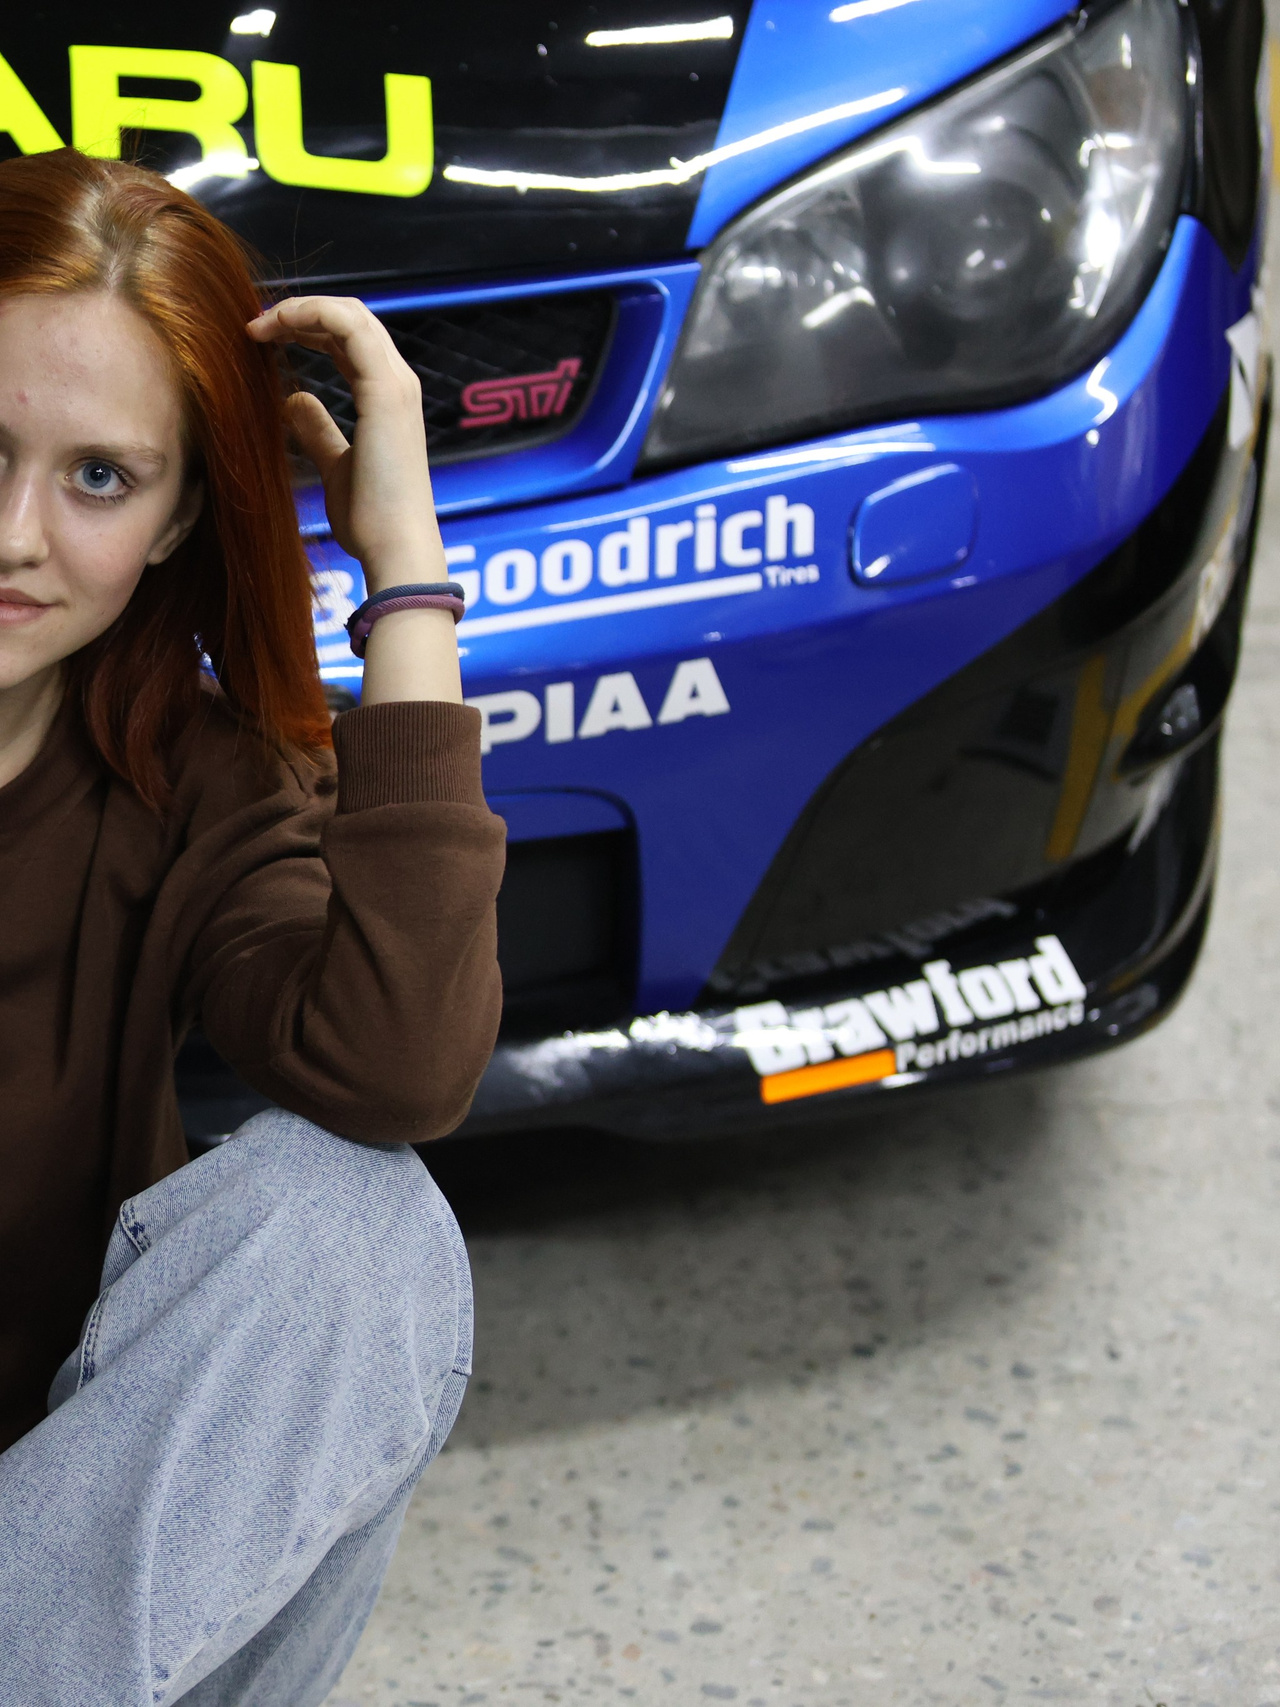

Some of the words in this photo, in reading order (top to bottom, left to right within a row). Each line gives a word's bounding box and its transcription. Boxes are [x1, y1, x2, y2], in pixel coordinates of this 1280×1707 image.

[310, 494, 815, 637] BGoodrich
[763, 563, 821, 589] Tires
[463, 656, 731, 755] PIAA
[734, 933, 1087, 1076] Crawford
[896, 1002, 1085, 1073] Performance
